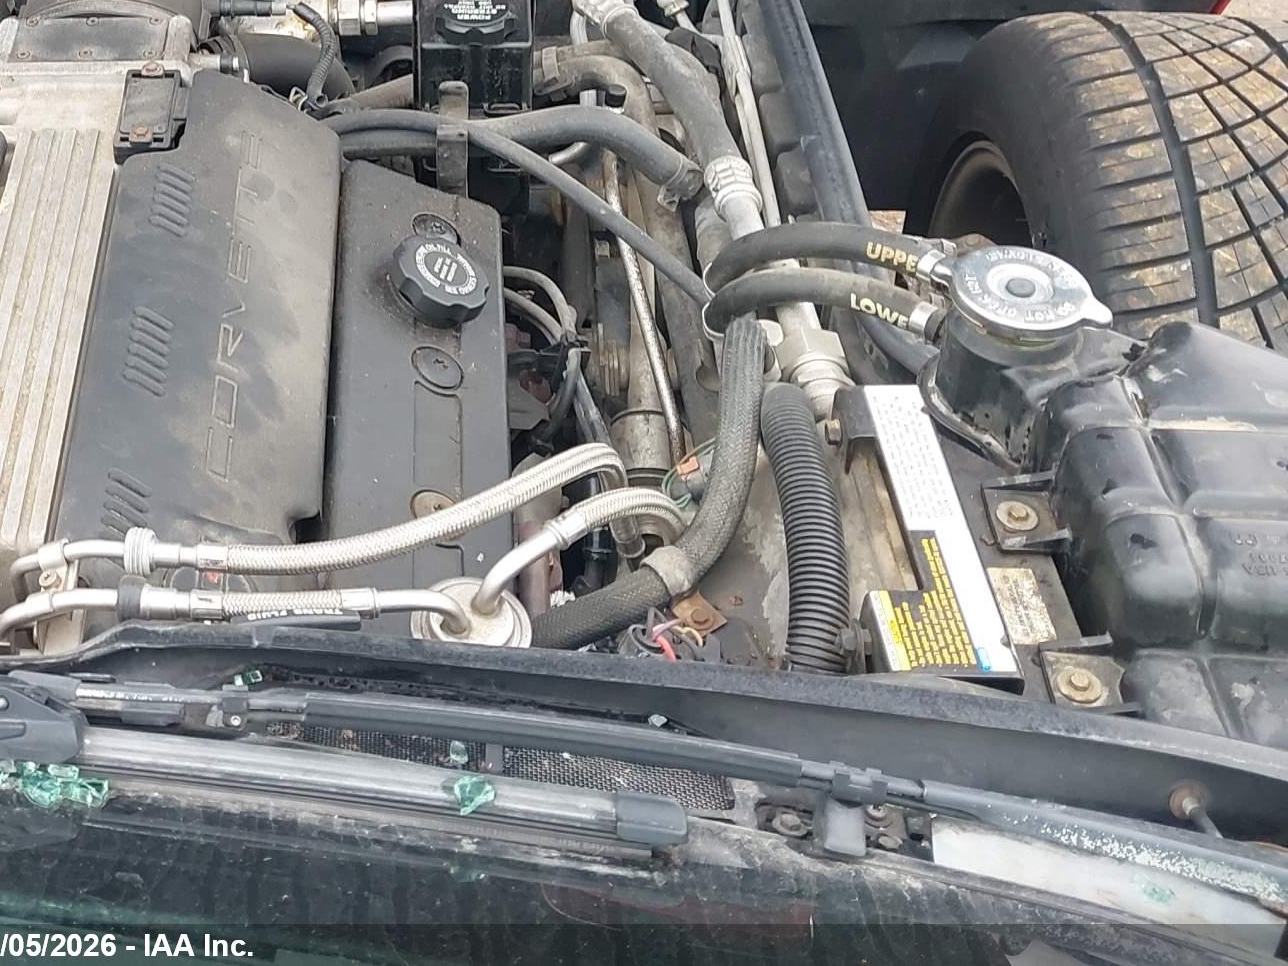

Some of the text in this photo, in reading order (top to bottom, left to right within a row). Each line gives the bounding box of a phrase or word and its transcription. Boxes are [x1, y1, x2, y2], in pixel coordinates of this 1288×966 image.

[866, 241, 919, 274] UPPE
[206, 130, 263, 482] CORVETTE
[850, 292, 910, 331] LOWE
